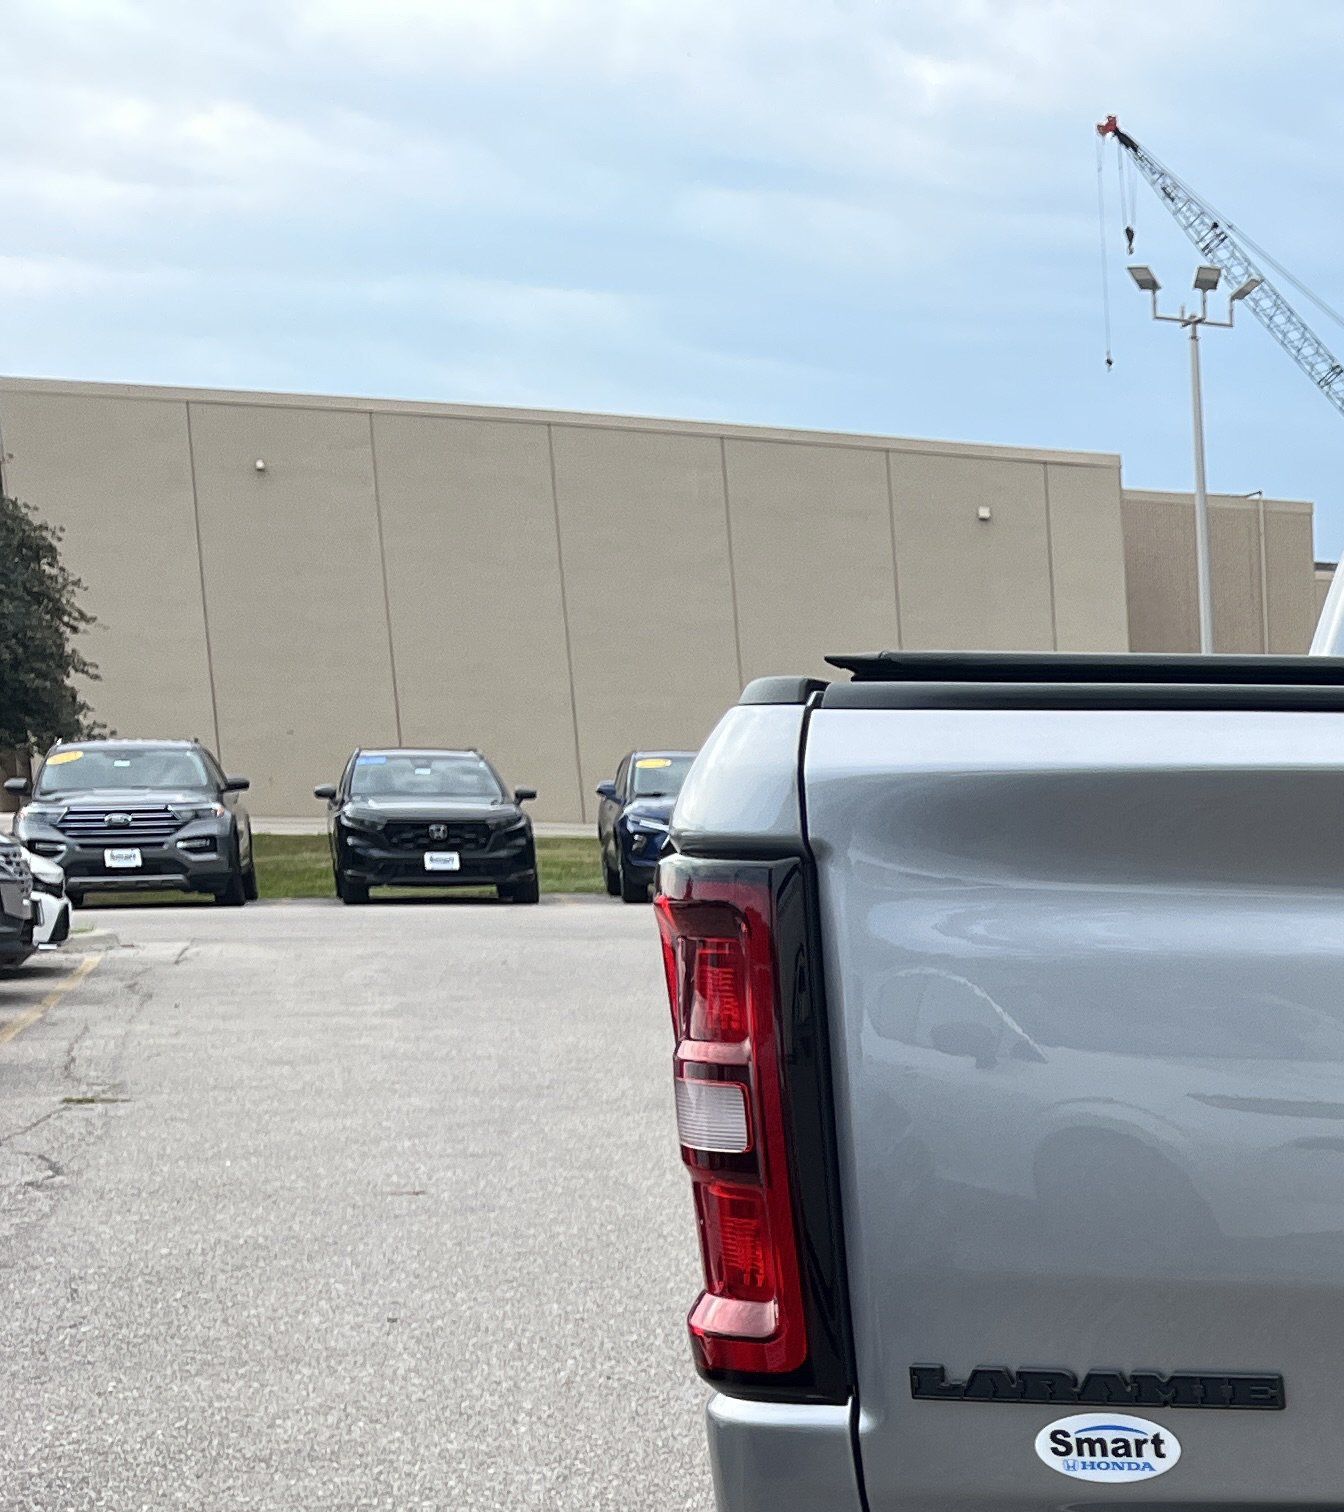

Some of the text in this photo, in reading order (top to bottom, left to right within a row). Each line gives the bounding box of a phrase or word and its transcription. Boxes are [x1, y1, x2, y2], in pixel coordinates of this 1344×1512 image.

[908, 1362, 1286, 1410] LARAMIE
[1049, 1429, 1167, 1459] Smart
[1081, 1461, 1157, 1472] HONDA
